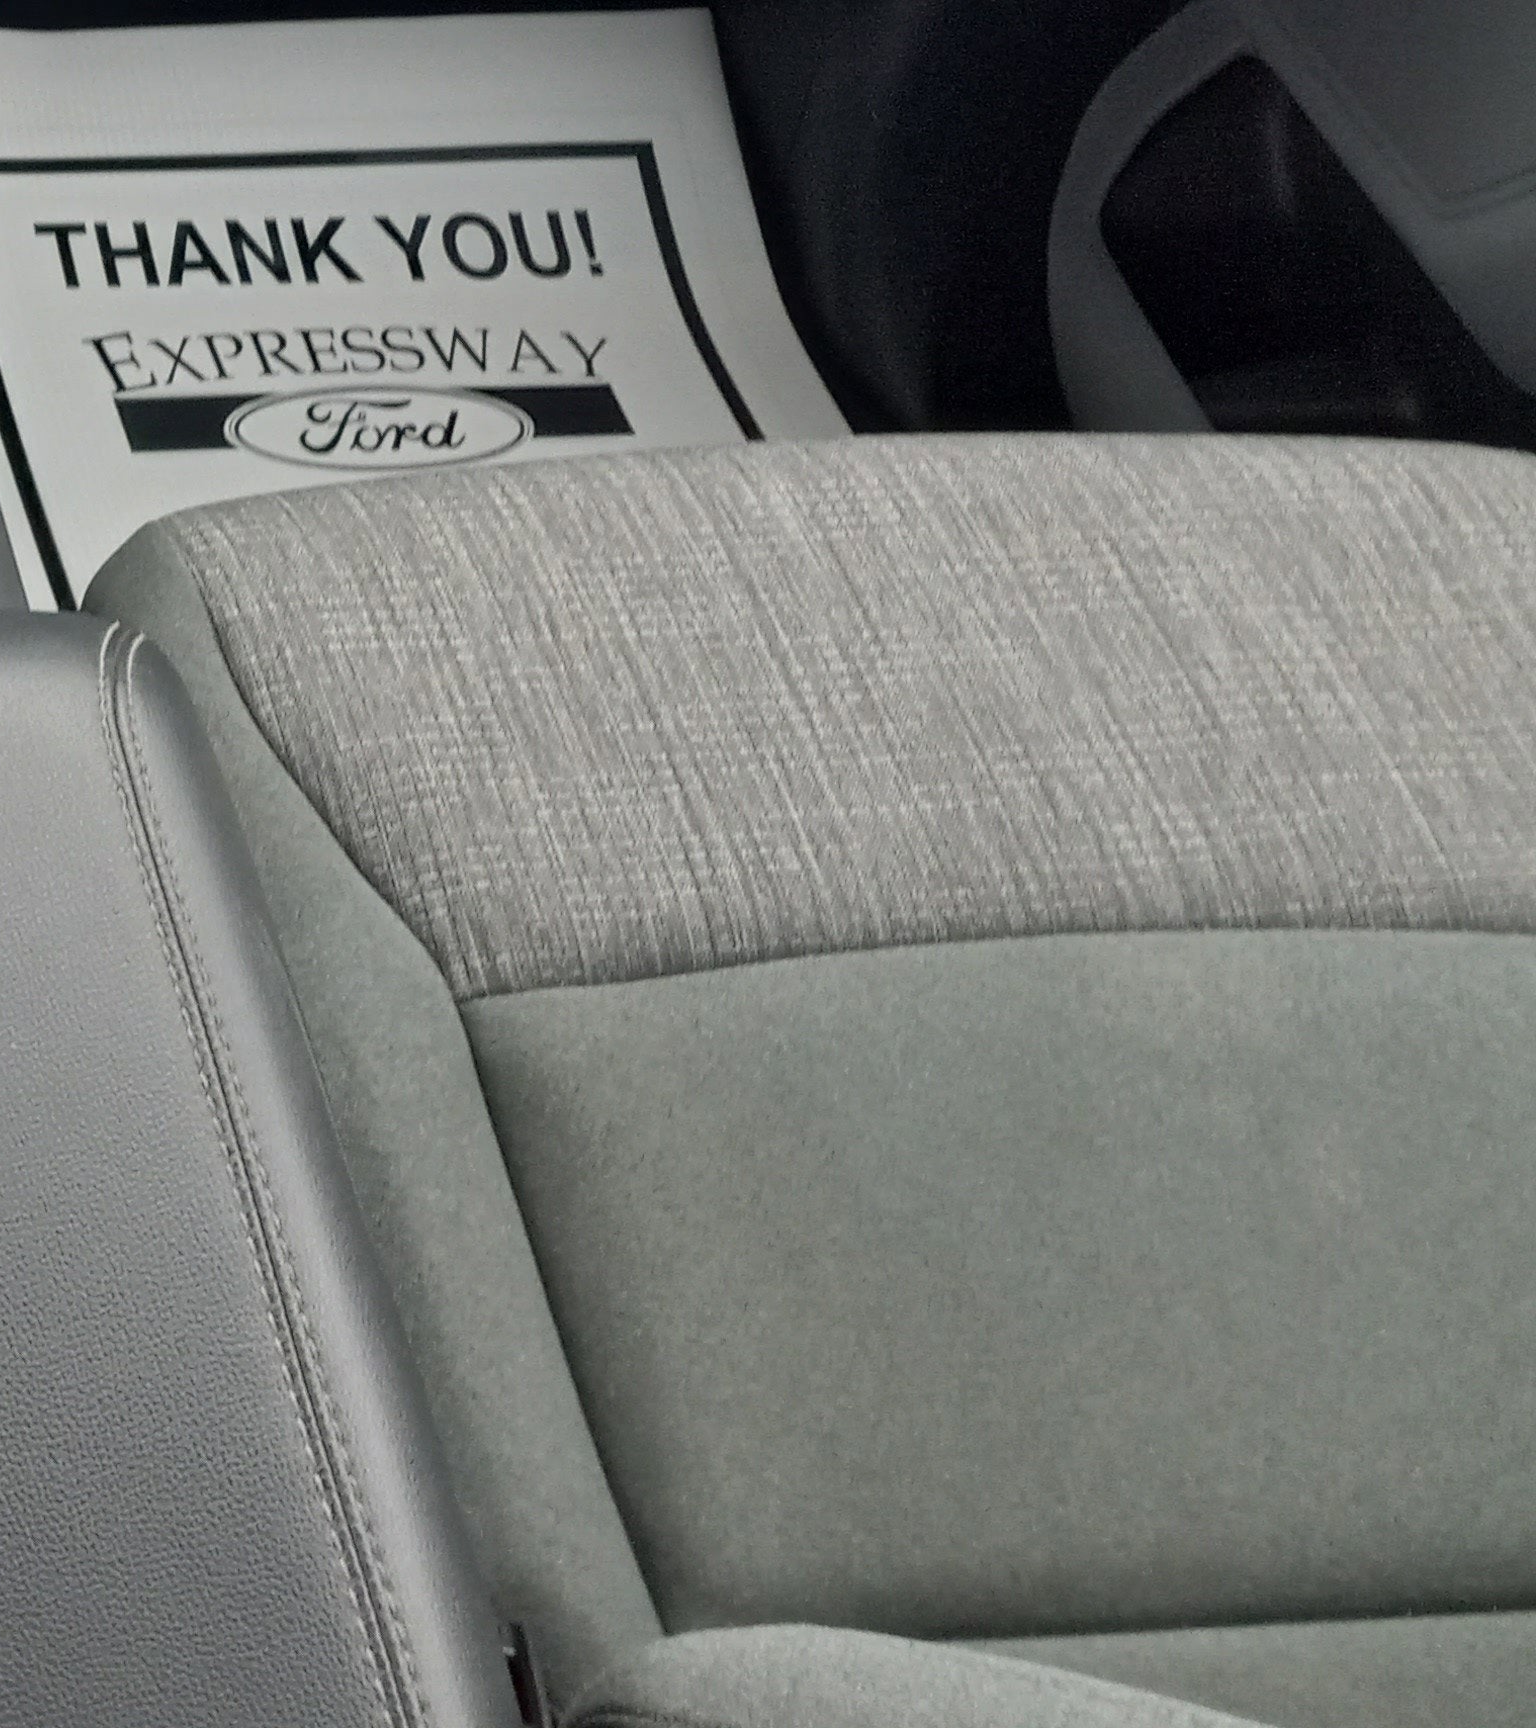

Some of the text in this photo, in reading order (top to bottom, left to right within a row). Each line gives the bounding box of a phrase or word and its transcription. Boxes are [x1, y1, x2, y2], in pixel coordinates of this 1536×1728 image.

[33, 208, 606, 290] THANK YOU!
[84, 326, 610, 394] EXPRESSWAY
[299, 397, 467, 454] Ford
